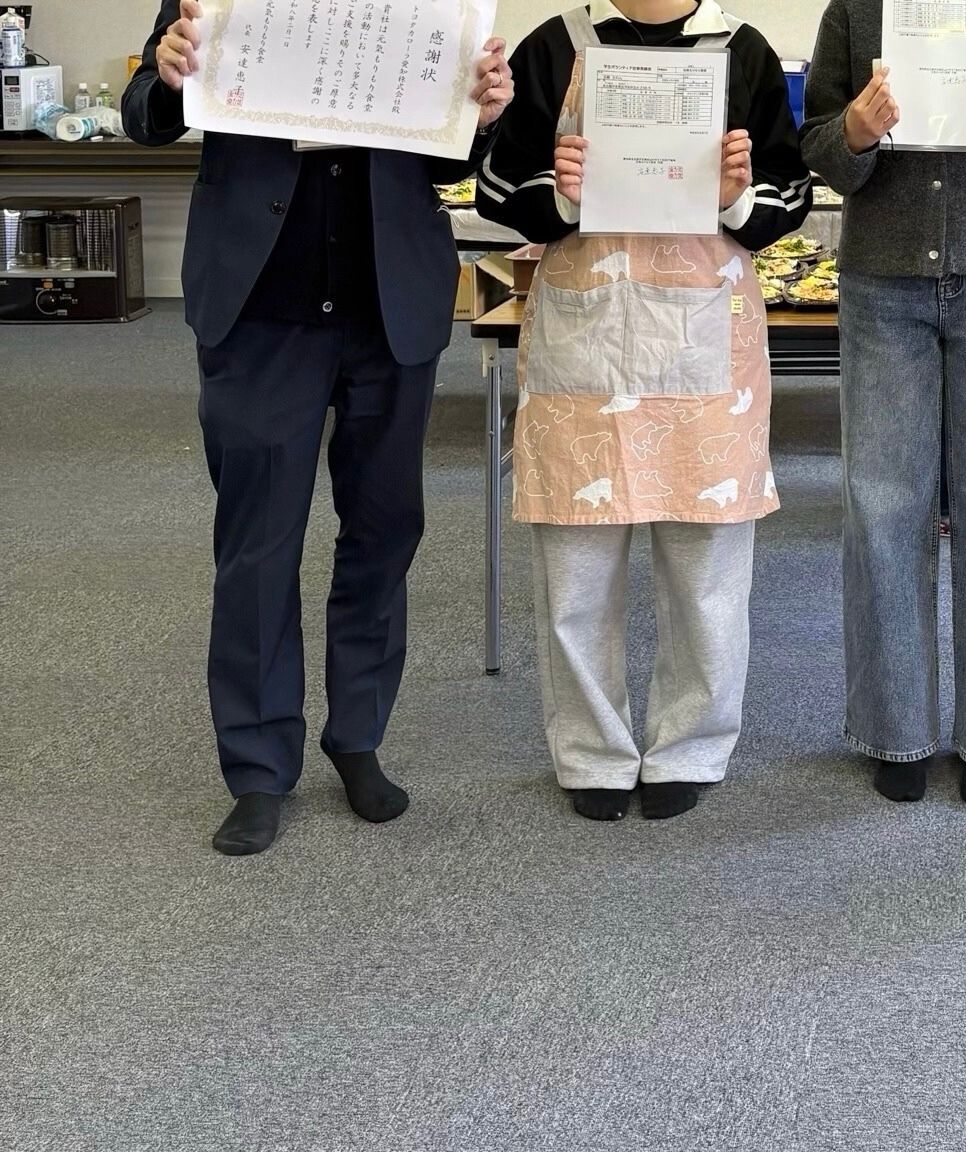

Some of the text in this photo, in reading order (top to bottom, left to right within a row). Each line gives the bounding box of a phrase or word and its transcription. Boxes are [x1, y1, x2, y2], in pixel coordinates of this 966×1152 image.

[256, 0, 275, 64] 元気もりもり食堂
[328, 0, 357, 108] ご支援を賜りそのご厚意
[347, 3, 374, 110] の活動において多大なる
[364, 4, 392, 112] 貴社は元気もりもり食堂
[420, 29, 445, 82] 感謝状
